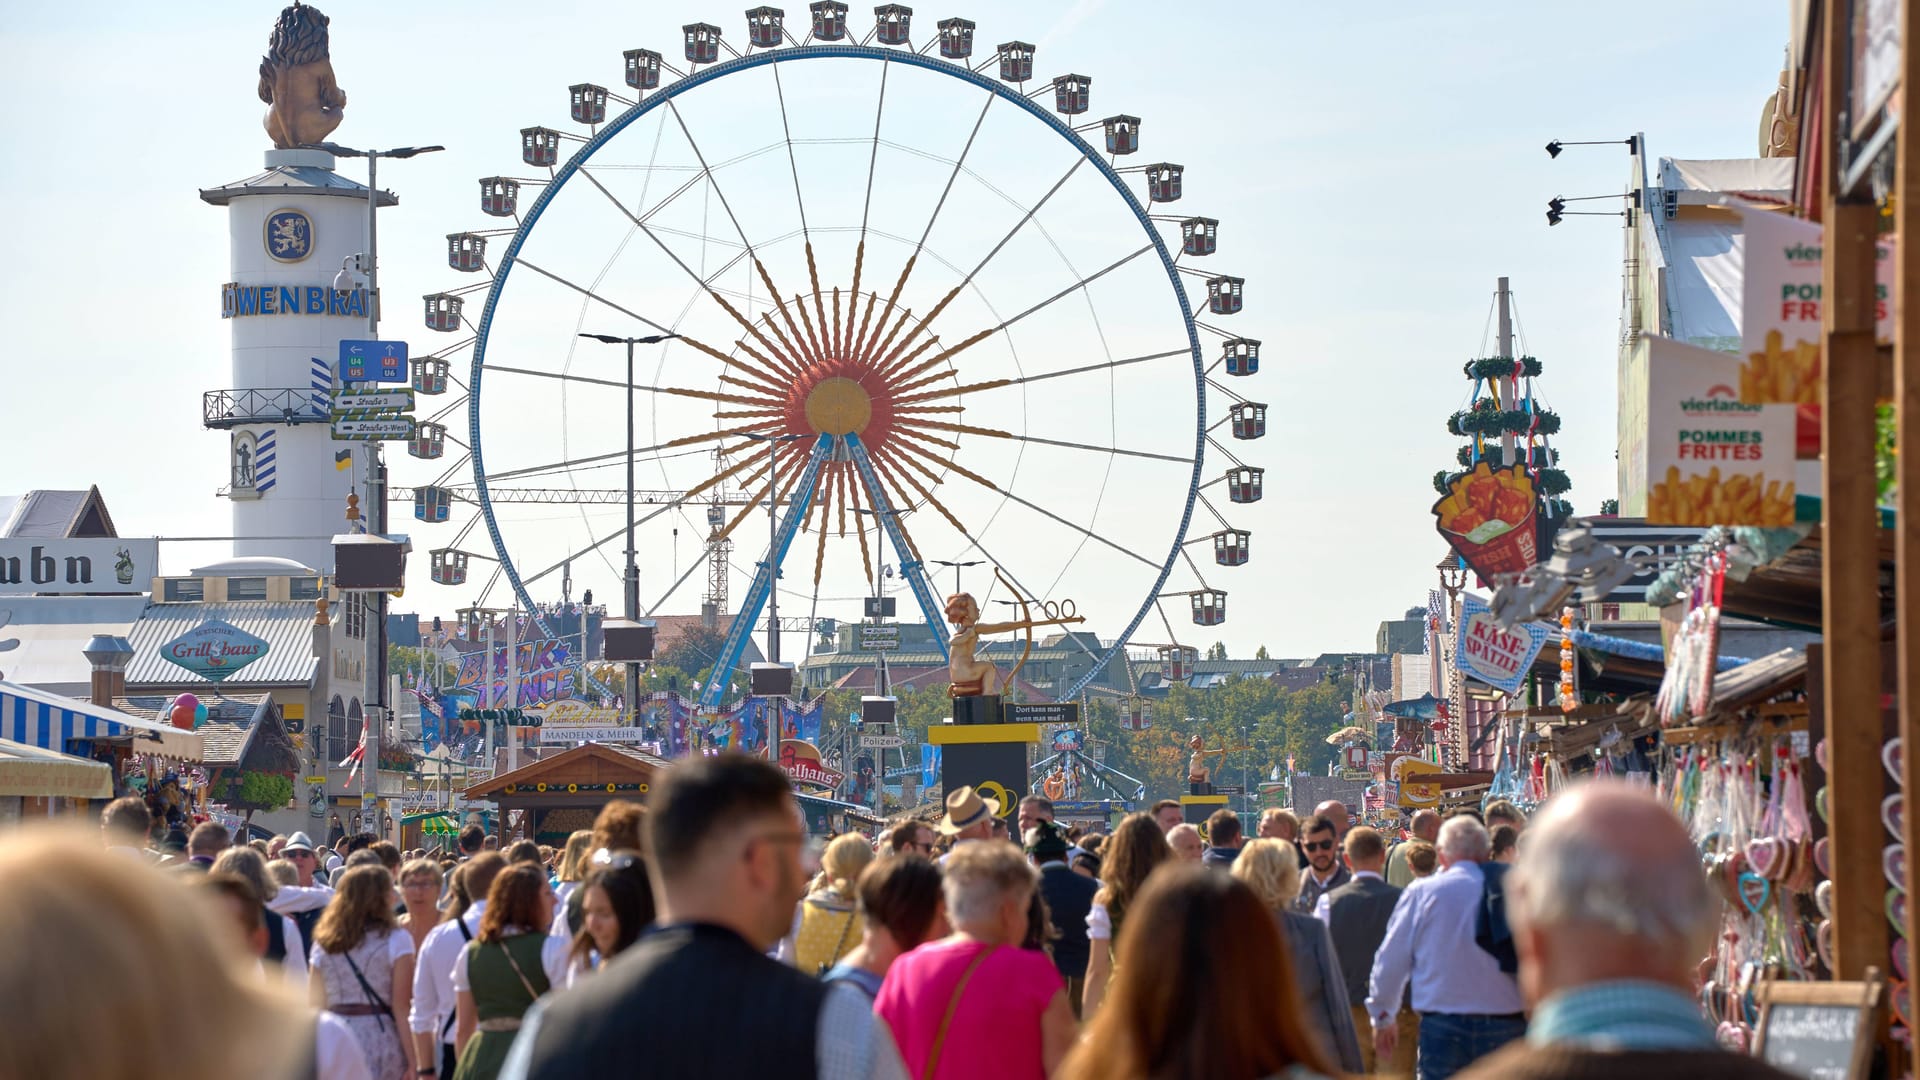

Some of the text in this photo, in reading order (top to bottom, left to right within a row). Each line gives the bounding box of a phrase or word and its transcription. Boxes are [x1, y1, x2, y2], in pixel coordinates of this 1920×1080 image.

[1679, 430, 1763, 443] POMMES
[1679, 444, 1763, 460] FRITES
[1465, 636, 1520, 674] SPÄTZLE
[545, 730, 637, 740] MANDELN & MEHR
[863, 737, 893, 746] Polizei
